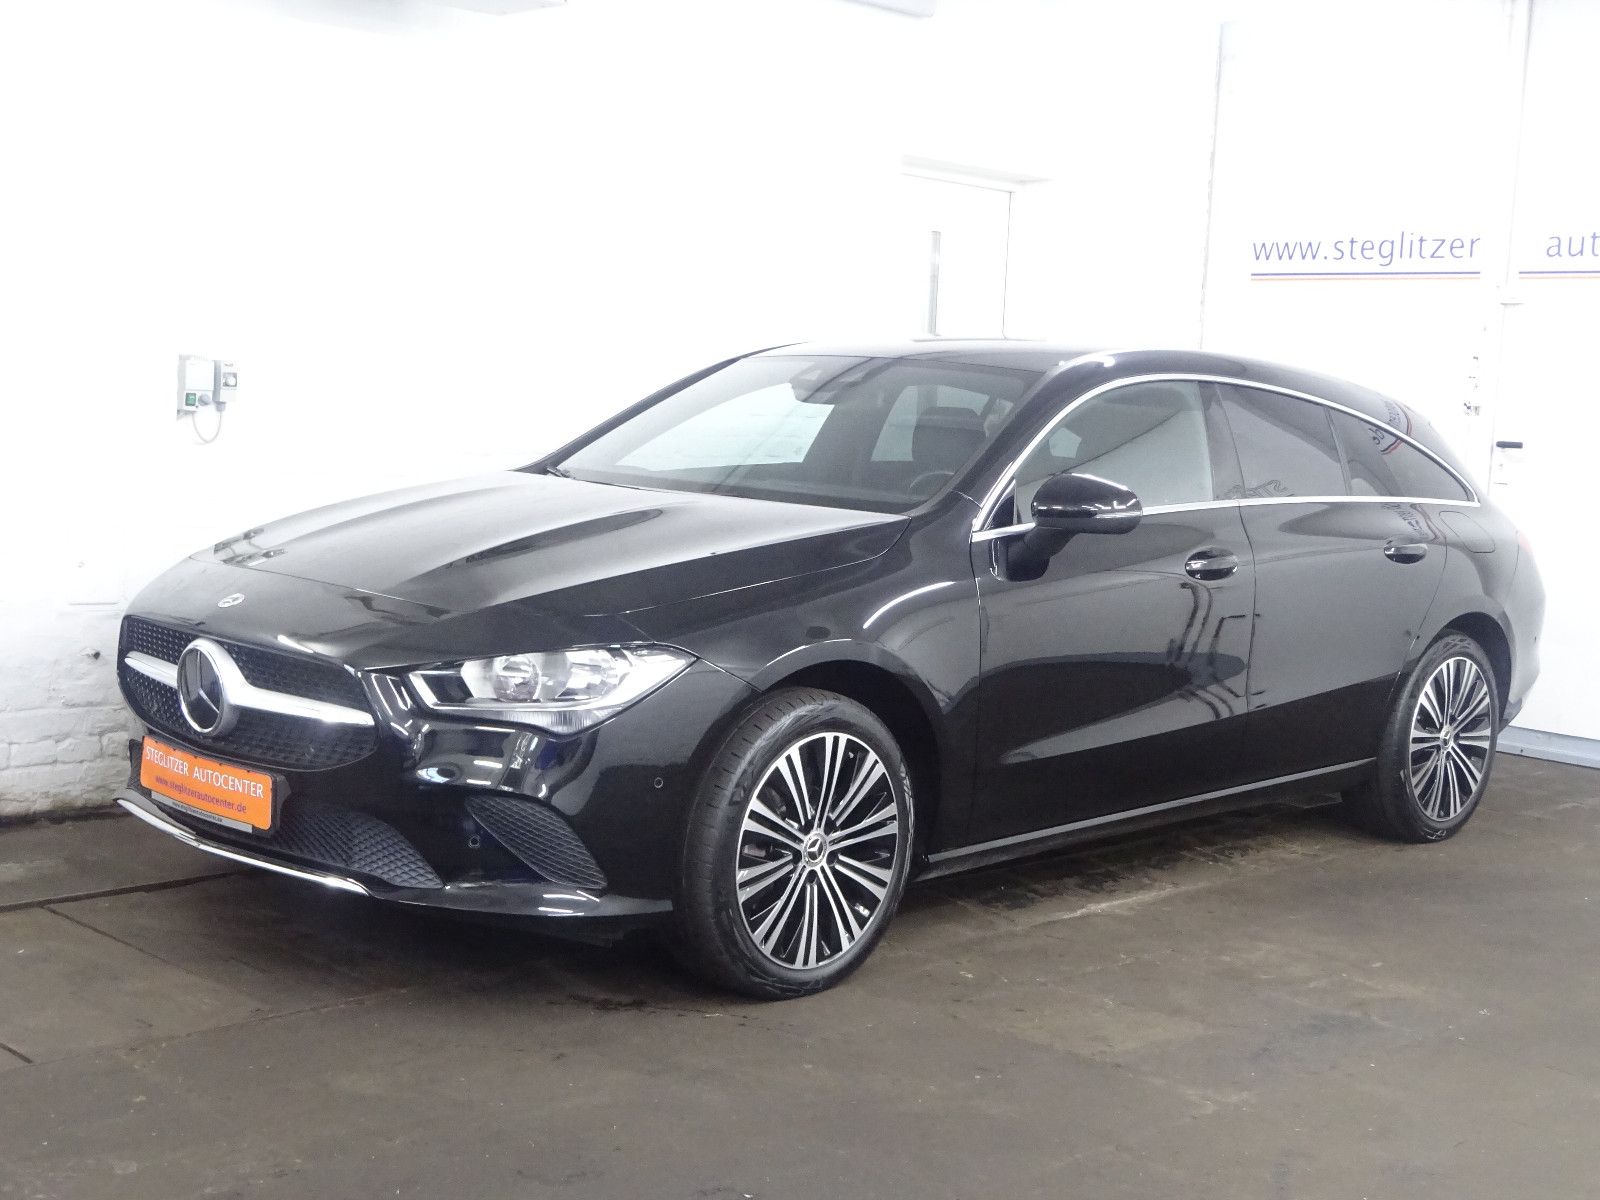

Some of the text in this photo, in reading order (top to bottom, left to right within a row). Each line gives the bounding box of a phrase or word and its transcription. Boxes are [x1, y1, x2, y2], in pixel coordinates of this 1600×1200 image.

[1253, 231, 1600, 266] www.steglitzer aut
[146, 746, 264, 798] STEGLITZER AUTOCENTER
